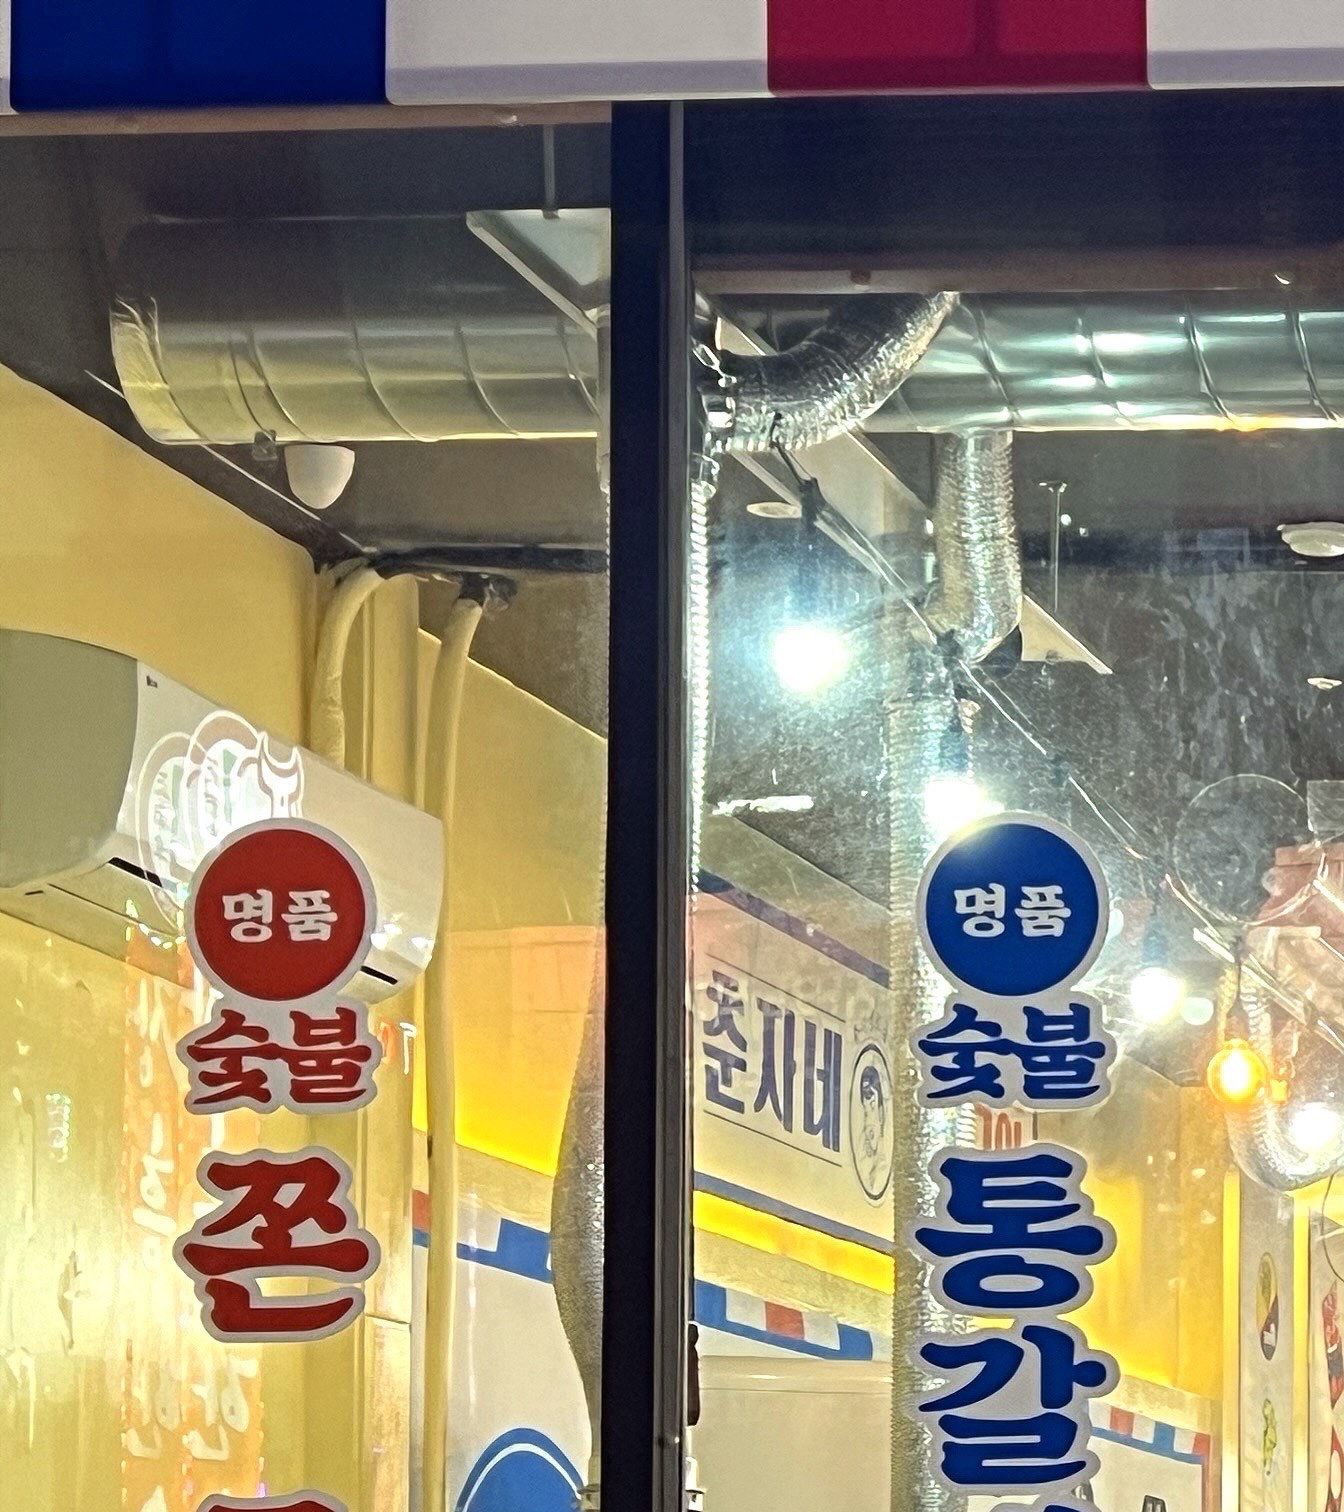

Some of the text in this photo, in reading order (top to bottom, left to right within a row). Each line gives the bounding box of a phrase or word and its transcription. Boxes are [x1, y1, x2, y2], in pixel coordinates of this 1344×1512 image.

[221, 889, 340, 944] 명품
[953, 882, 1071, 939] 명품
[187, 1007, 373, 1105] 숯불
[702, 969, 843, 1153] 춘자네
[917, 1002, 1106, 1100] 숯불
